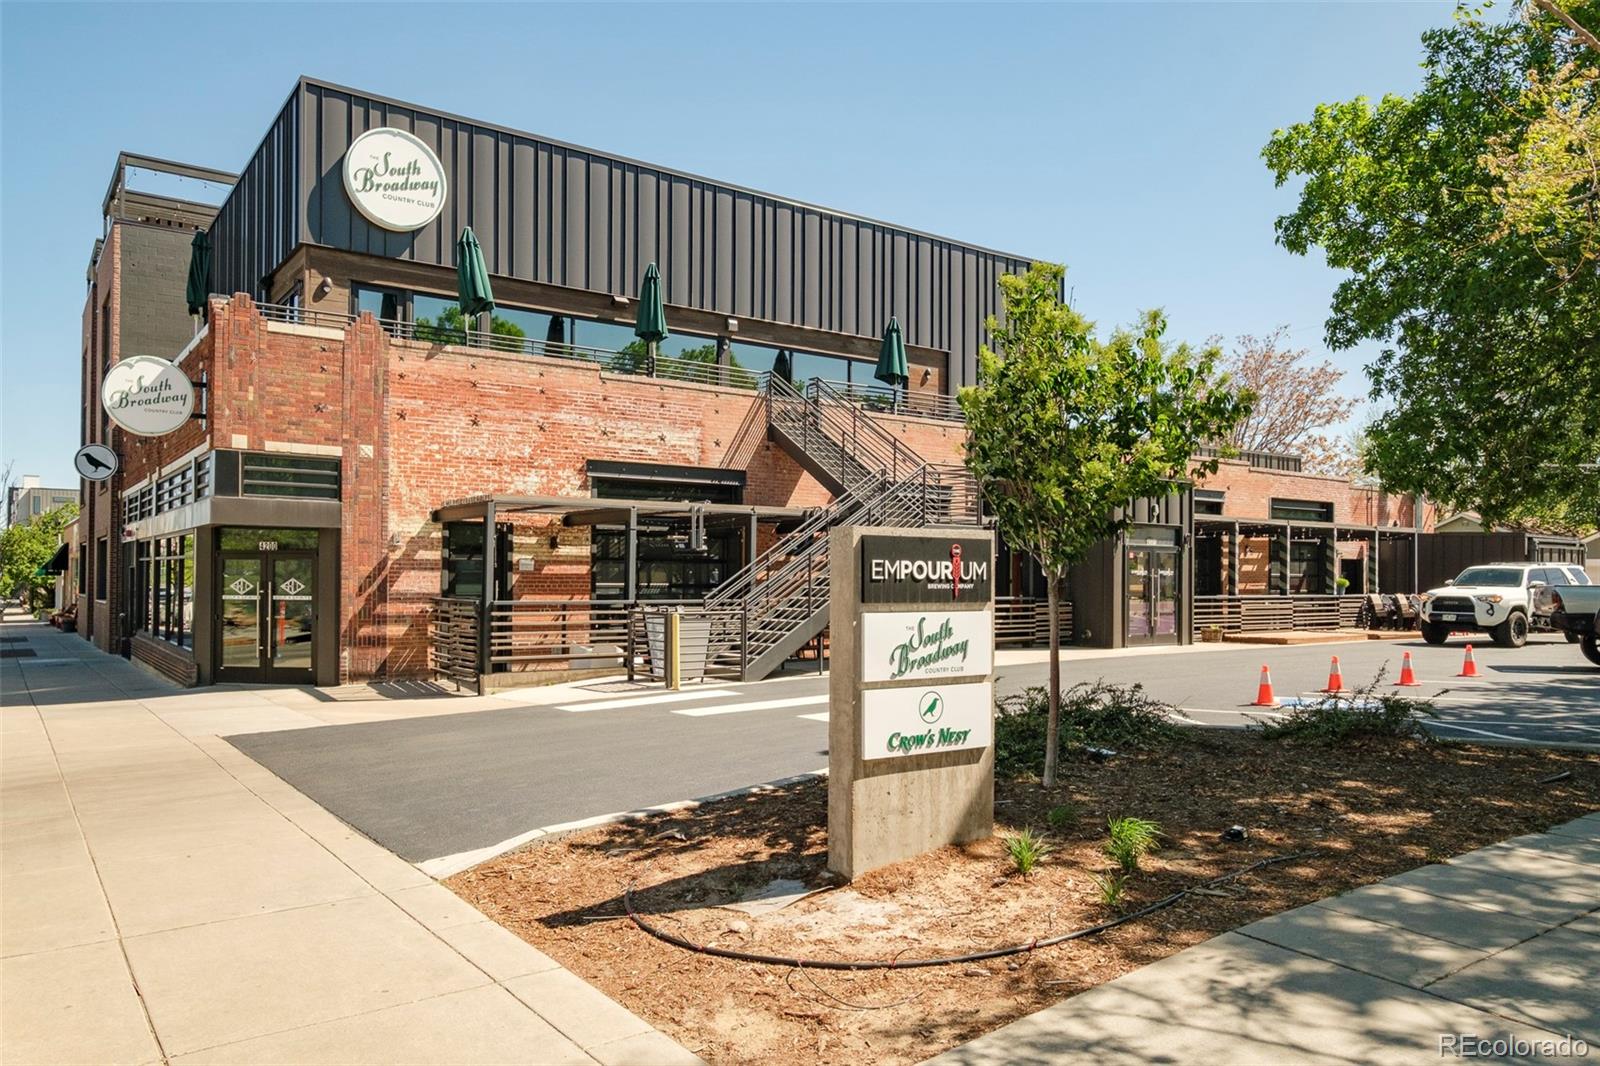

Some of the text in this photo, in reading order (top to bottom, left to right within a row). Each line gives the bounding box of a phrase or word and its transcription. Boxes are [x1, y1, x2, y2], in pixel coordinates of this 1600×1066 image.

[374, 152, 421, 177] South
[354, 168, 438, 197] Broadway
[382, 193, 435, 208] COUNTRY CLUB
[129, 375, 172, 395] South
[110, 391, 187, 409] Broadway
[872, 558, 987, 580] EMPOURIUM
[908, 616, 954, 653] South
[889, 638, 969, 680] Broadway
[925, 665, 964, 674] COUNTRY CLUB
[938, 727, 971, 749] NEST
